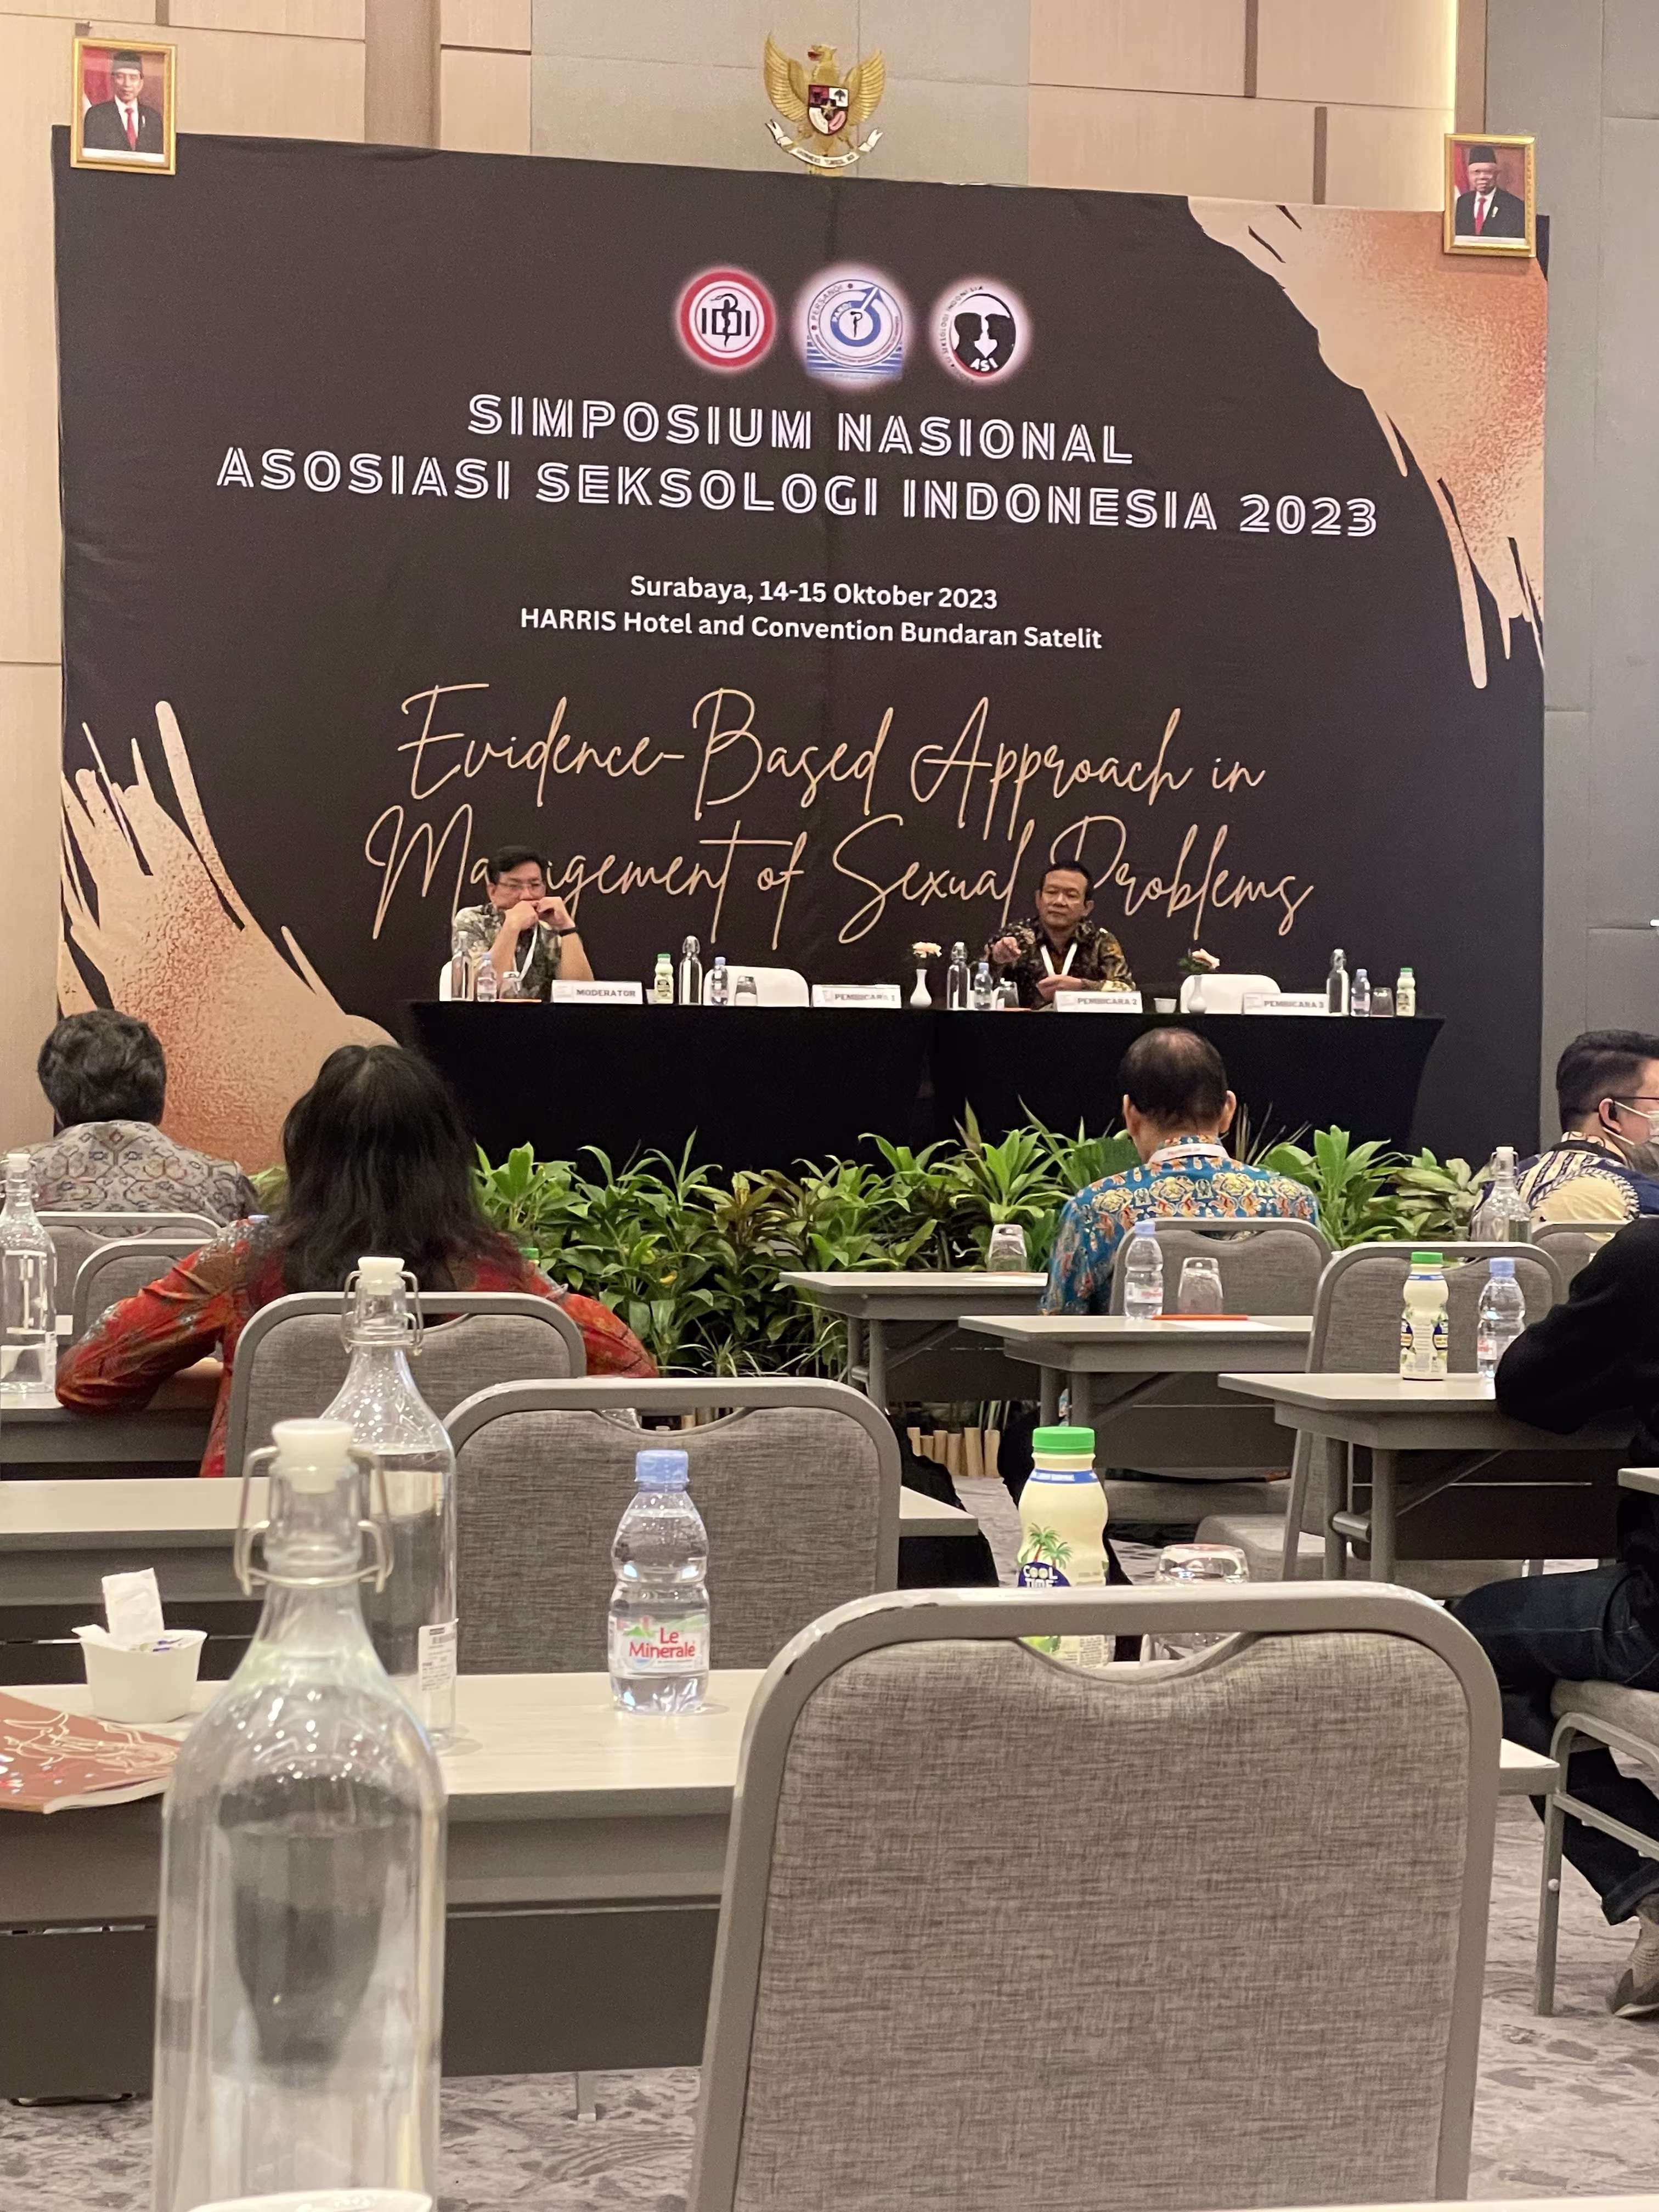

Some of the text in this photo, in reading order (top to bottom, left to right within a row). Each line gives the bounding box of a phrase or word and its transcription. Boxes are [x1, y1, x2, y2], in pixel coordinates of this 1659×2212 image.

[969, 357, 999, 371] ASI
[467, 394, 1133, 464] SIMPOSIUM NASIONAL
[216, 447, 1376, 537] ASOSIASI SEKSOLOGI INDONESIA 2023
[630, 575, 998, 610] Surabaya, 14-15 Oktober 2023
[521, 607, 1102, 649] HARRIS Hotel and Convention Bundaran Satelit
[397, 683, 1266, 841] Evidence-Based Approach in
[757, 831, 806, 950] of
[832, 814, 1035, 944] Sexual
[1049, 815, 1314, 941] Problems
[576, 989, 636, 997] MODERATOR
[1023, 1565, 1058, 1580] COOL
[629, 1641, 696, 1658] Minerale
[660, 1627, 679, 1644] Le
